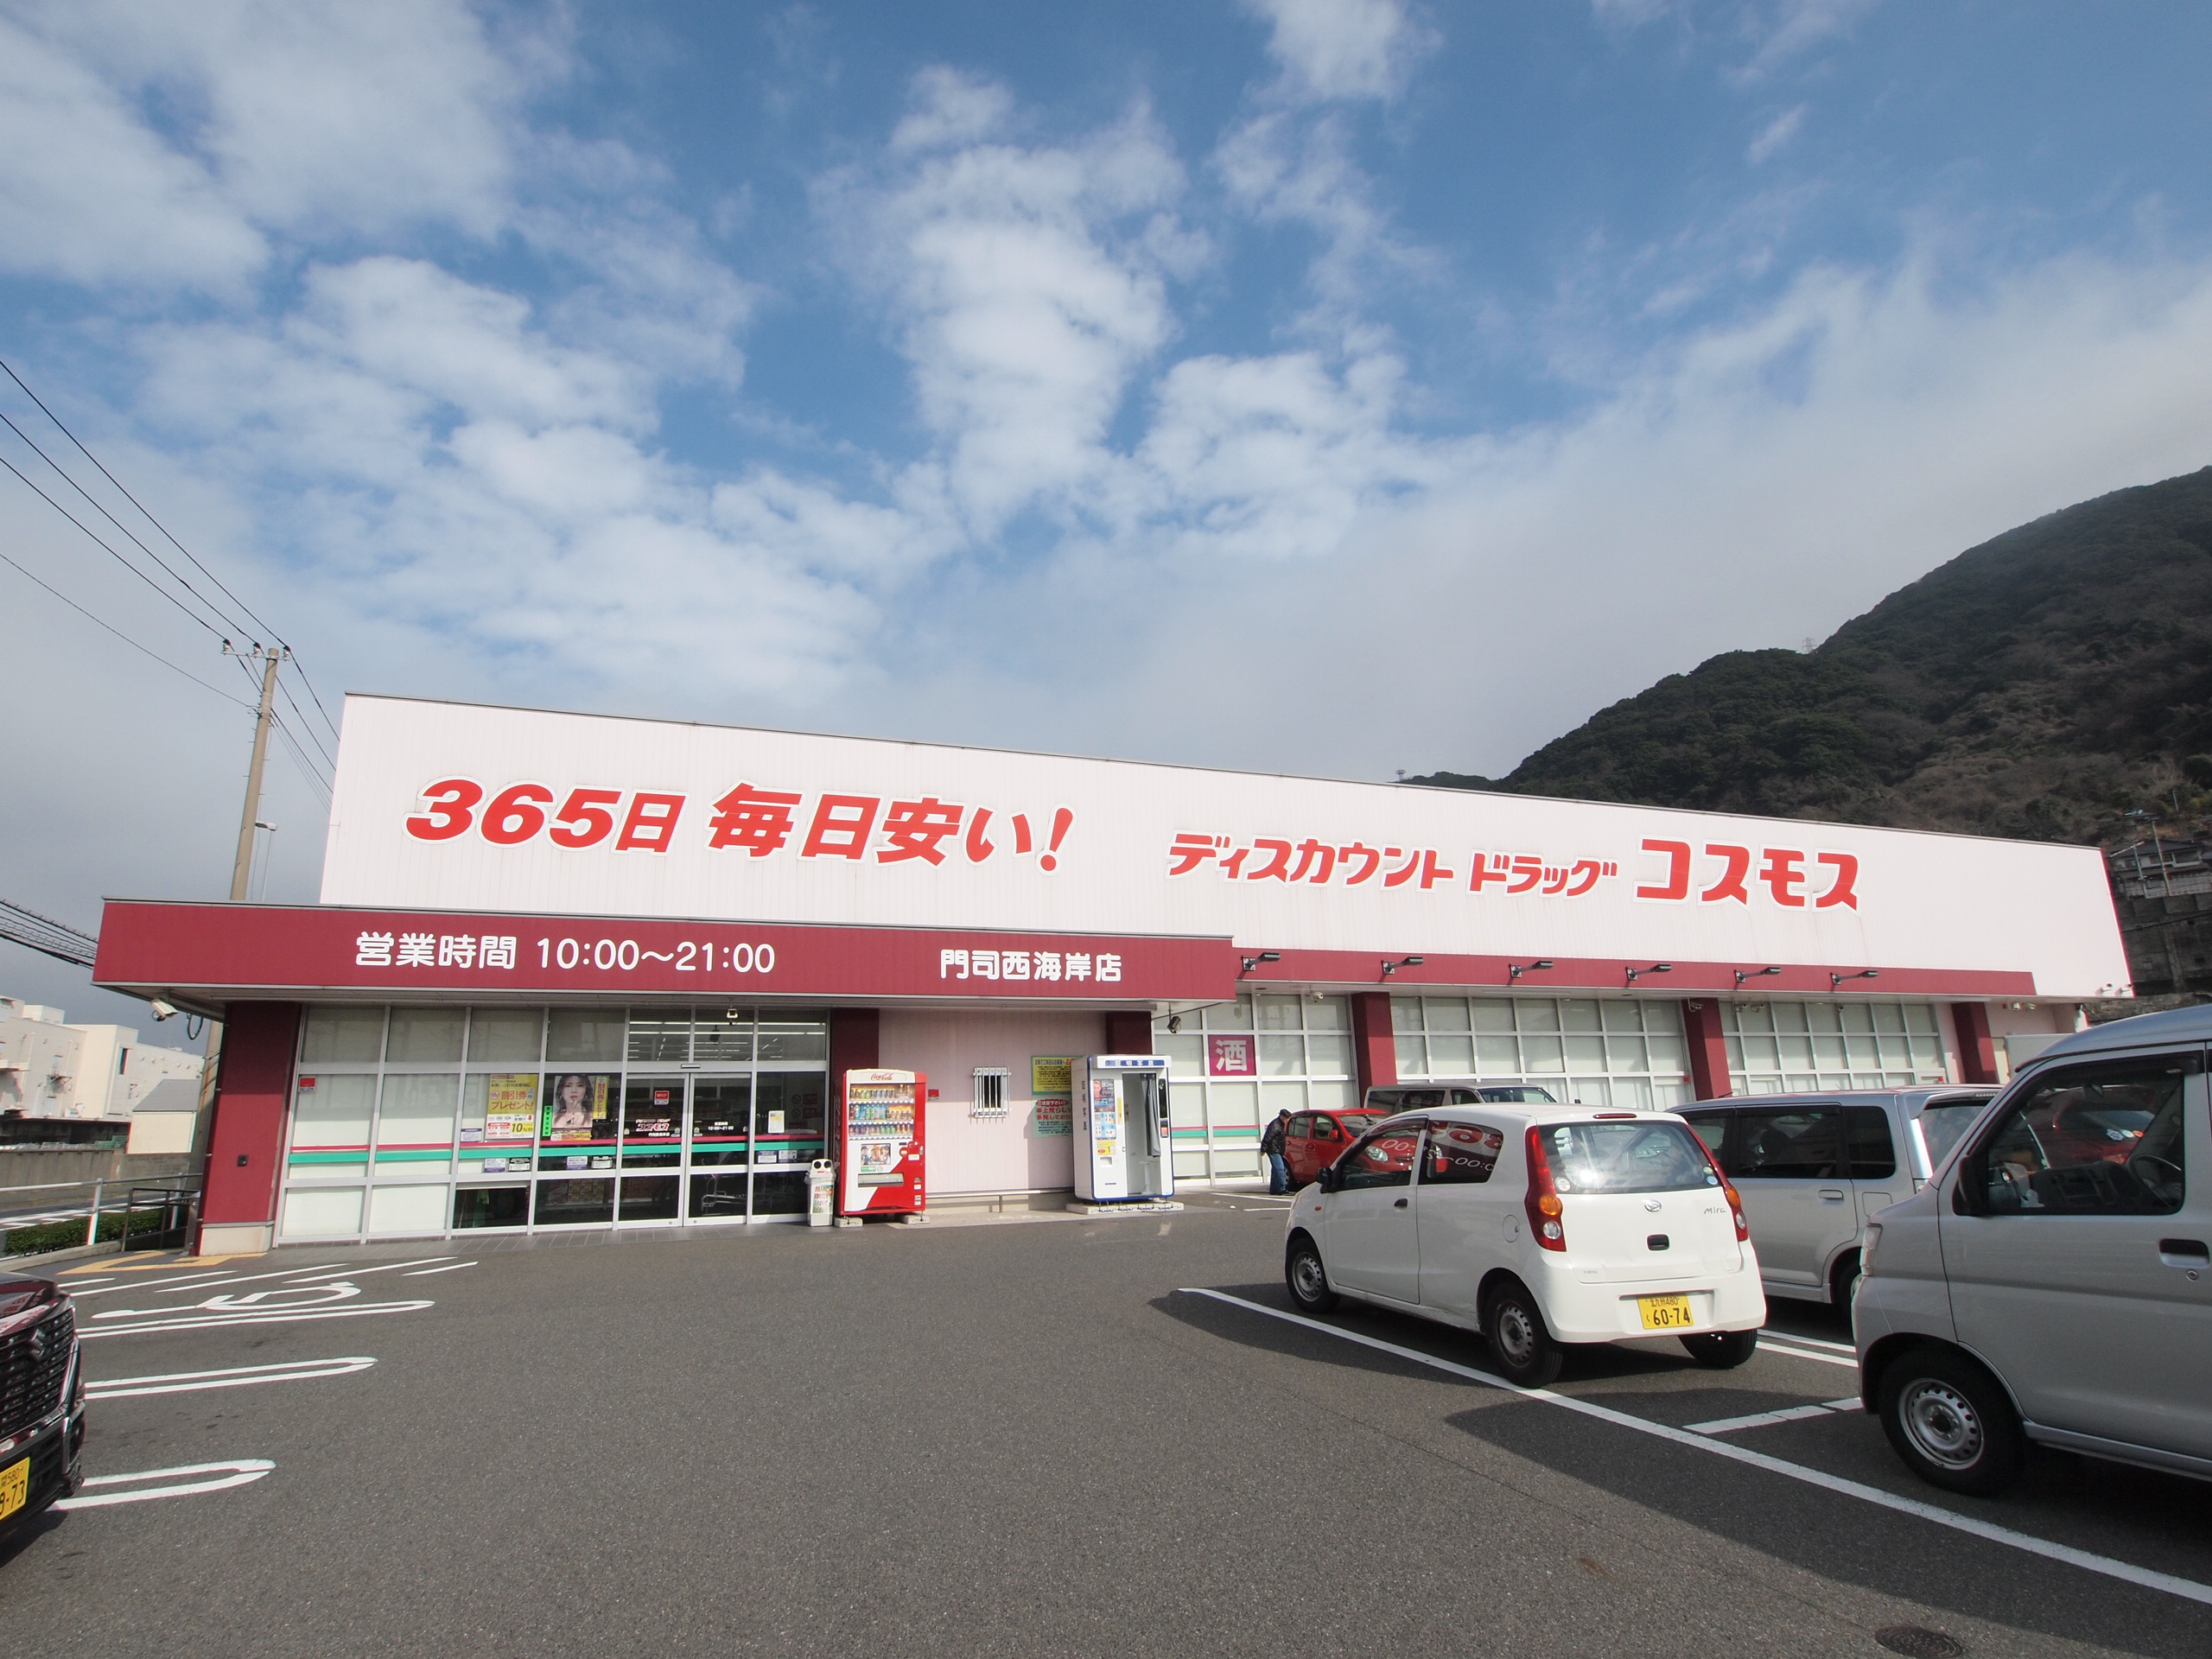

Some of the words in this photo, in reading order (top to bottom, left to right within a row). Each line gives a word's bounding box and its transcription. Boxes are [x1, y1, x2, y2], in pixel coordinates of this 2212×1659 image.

[405, 779, 687, 854] 365日
[708, 782, 1073, 873] 毎日安い!
[1170, 833, 1454, 890] ディスカウント
[1471, 852, 1618, 897] ドラッグ
[1637, 838, 1859, 911] コスモス
[355, 931, 517, 969] 営業時間
[940, 949, 1122, 982] 門司西海岸店
[1216, 1039, 1247, 1071] 酒
[501, 1090, 526, 1100] 割引券
[512, 1123, 523, 1133] 10
[1650, 1297, 1679, 1306] 北九州480
[1653, 1306, 1690, 1325] 60-74
